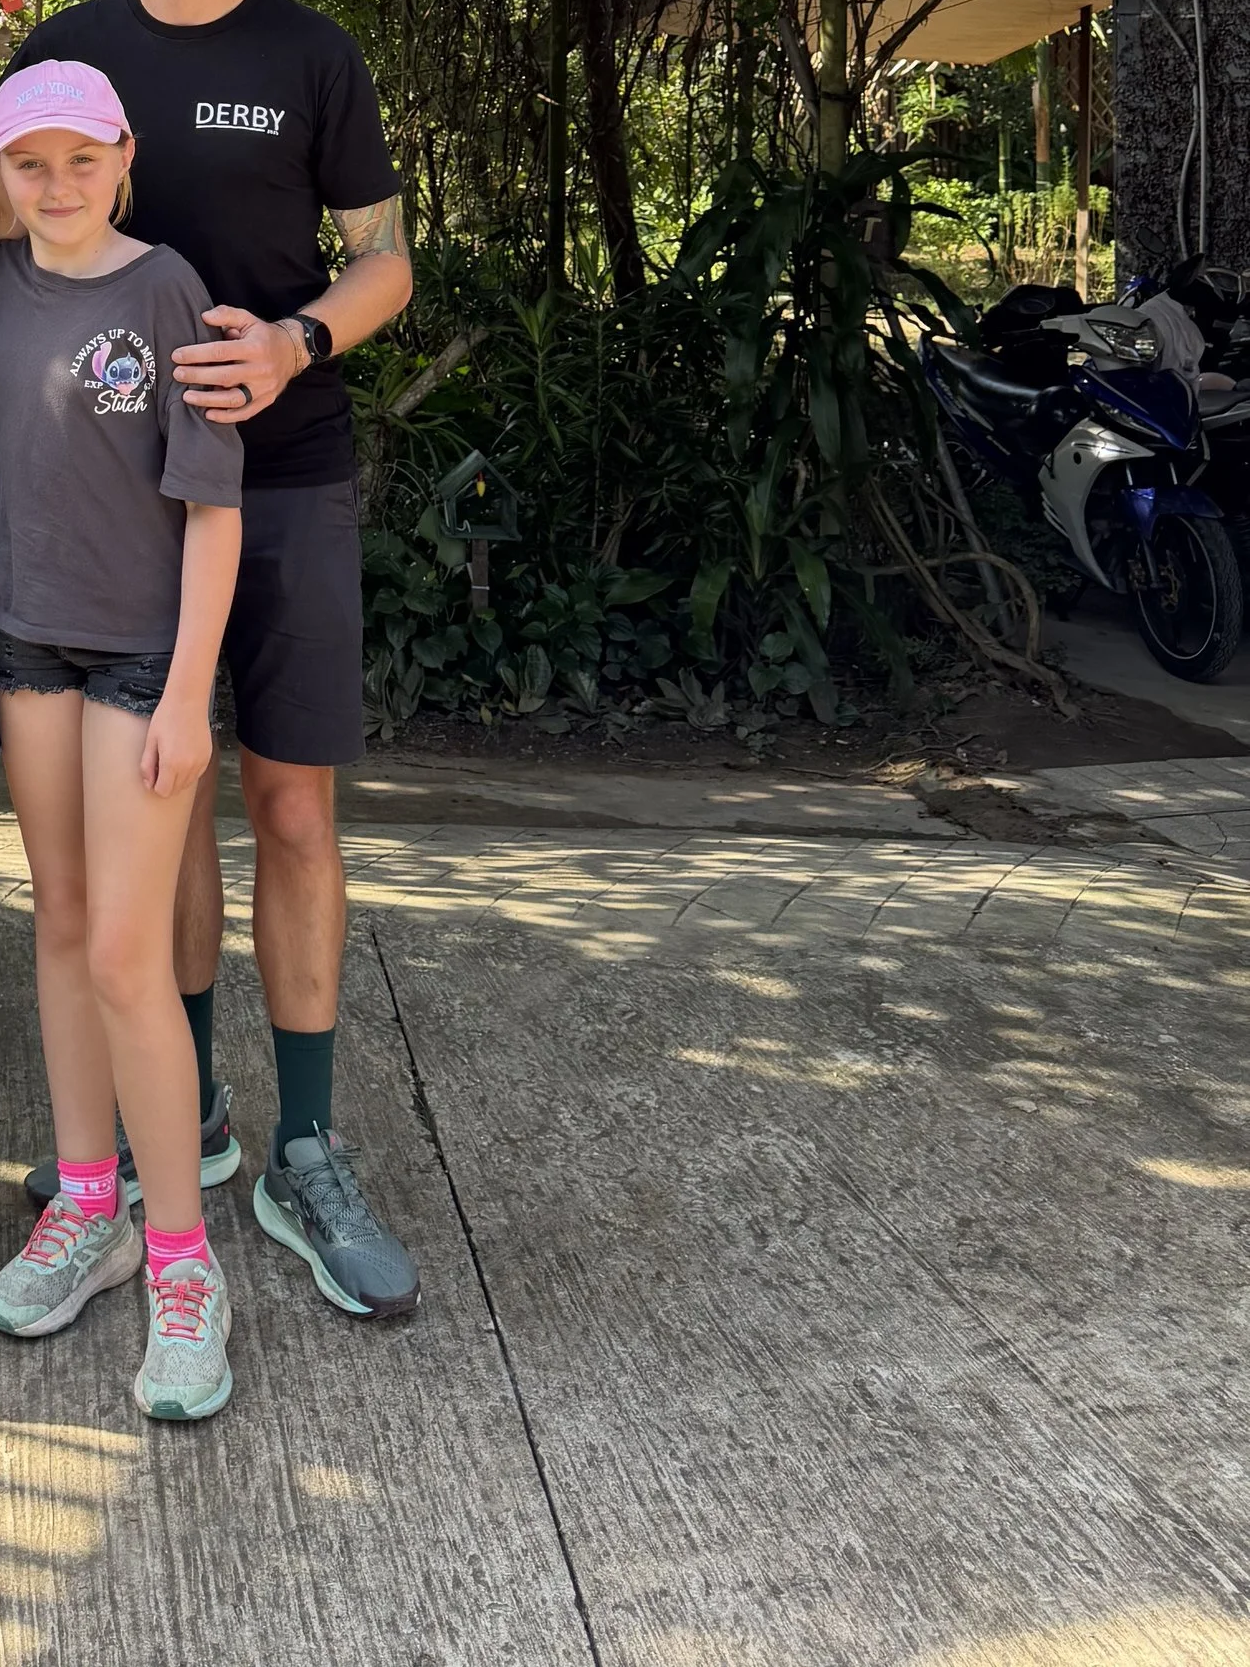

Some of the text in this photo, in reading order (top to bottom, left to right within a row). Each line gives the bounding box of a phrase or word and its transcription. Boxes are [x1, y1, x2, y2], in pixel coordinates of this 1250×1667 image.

[16, 81, 85, 110] NEW YORK
[195, 102, 285, 131] DERBY
[69, 333, 107, 377] ALWAYS
[108, 328, 126, 340] UP
[127, 331, 144, 348] TO
[83, 379, 104, 390] EXP.
[94, 390, 148, 415] Stitch
